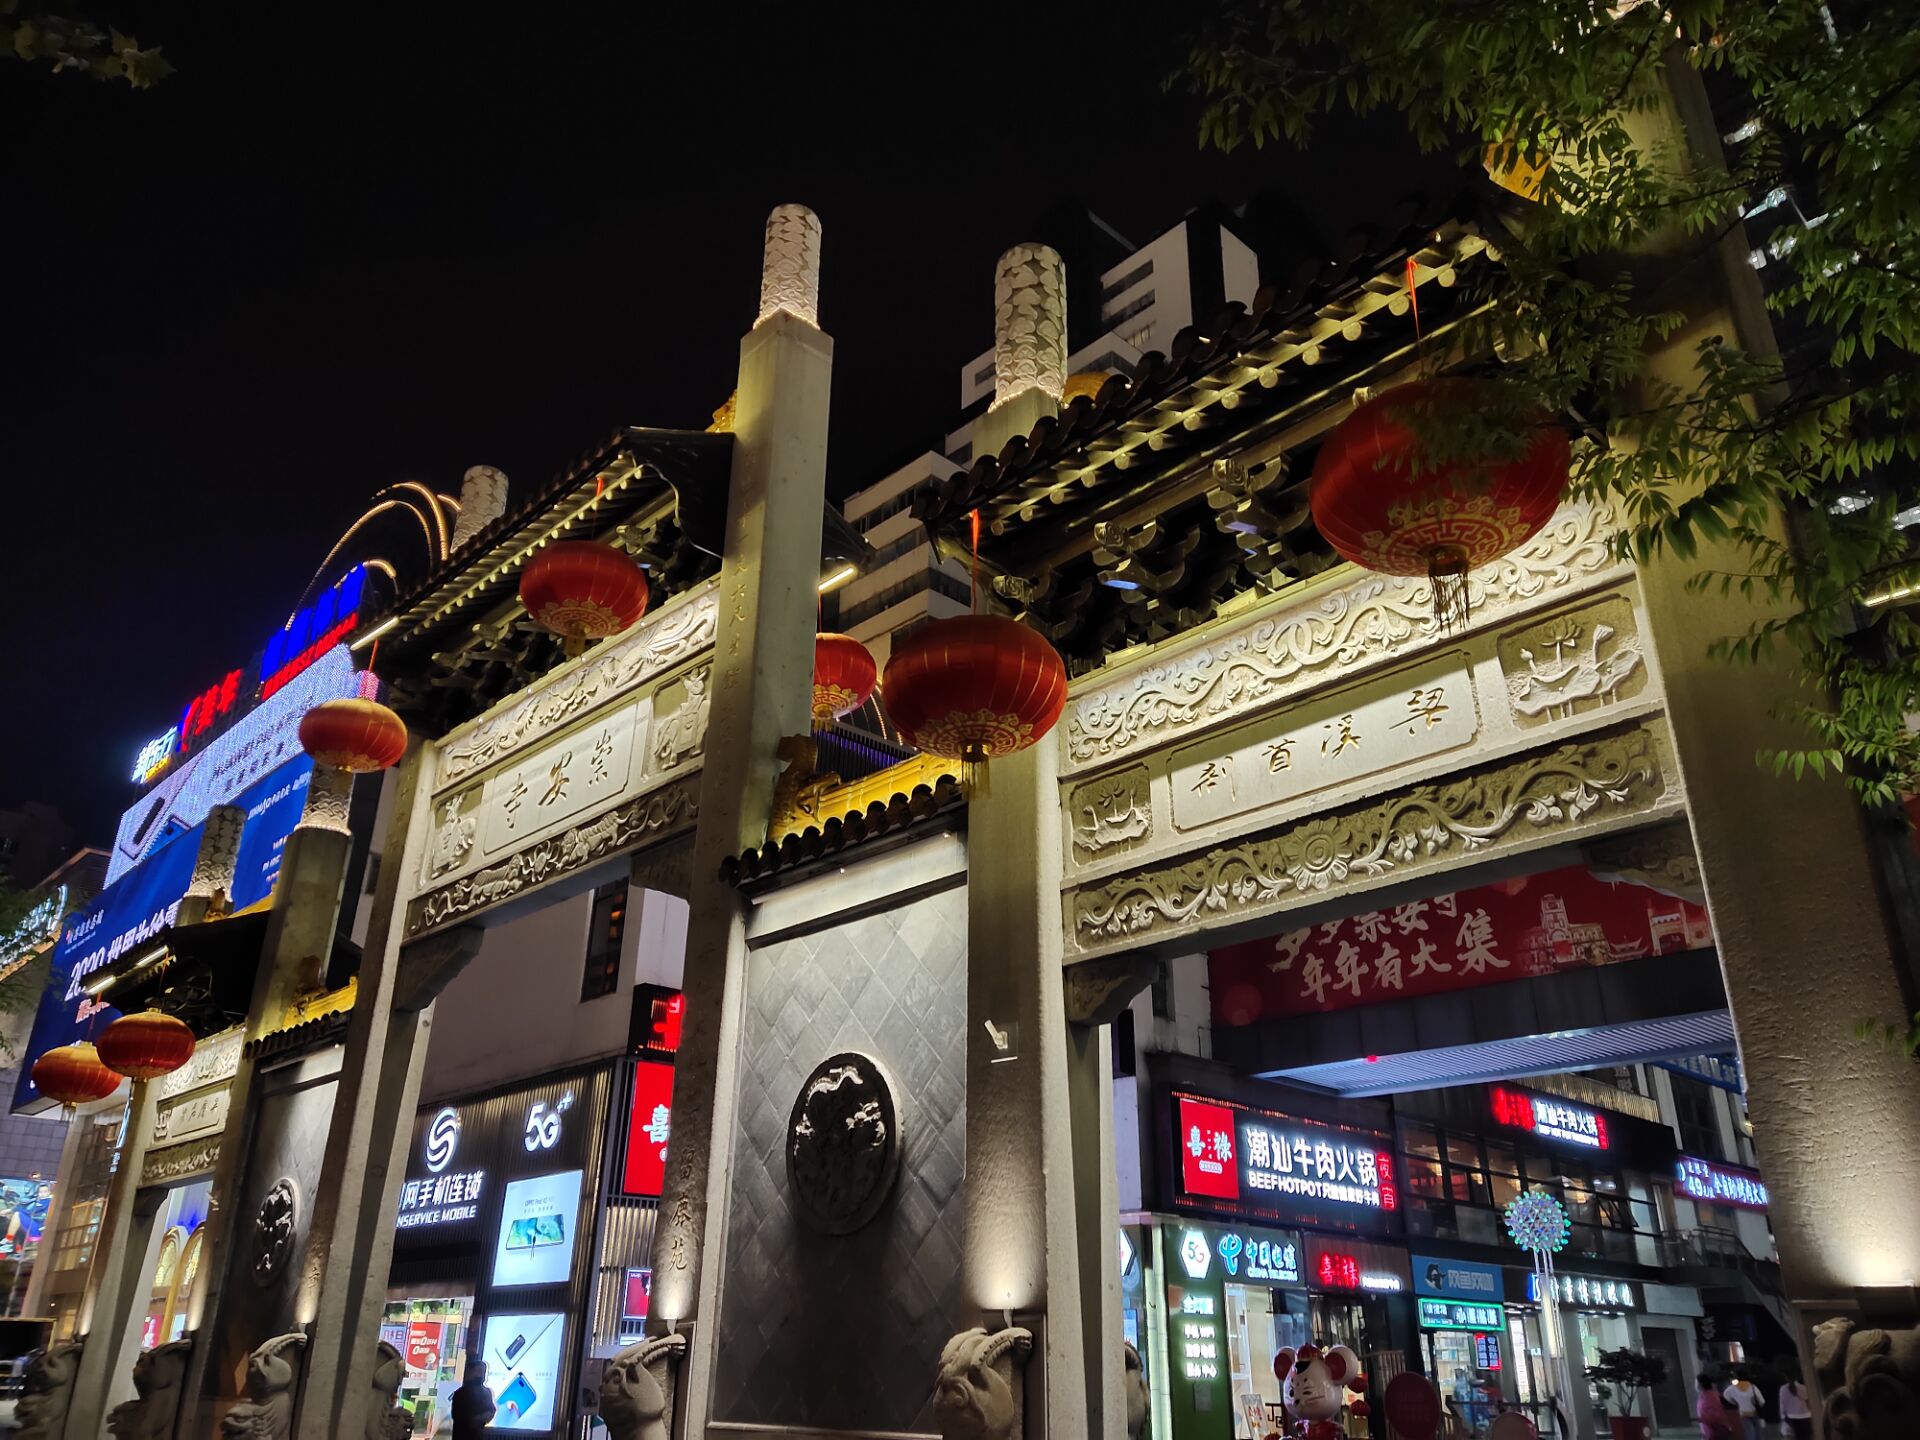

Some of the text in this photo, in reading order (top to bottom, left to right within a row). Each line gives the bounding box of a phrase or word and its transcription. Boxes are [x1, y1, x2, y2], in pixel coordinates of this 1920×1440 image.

[1300, 908, 1511, 1003] 年年有大集
[1247, 1128, 1379, 1188] 潮汕牛肉火锅
[400, 1171, 486, 1211] 网手机连锁
[441, 1204, 477, 1222] MOBILE
[1188, 1241, 1205, 1263] 5G
[1245, 1237, 1298, 1271] 中国电信
